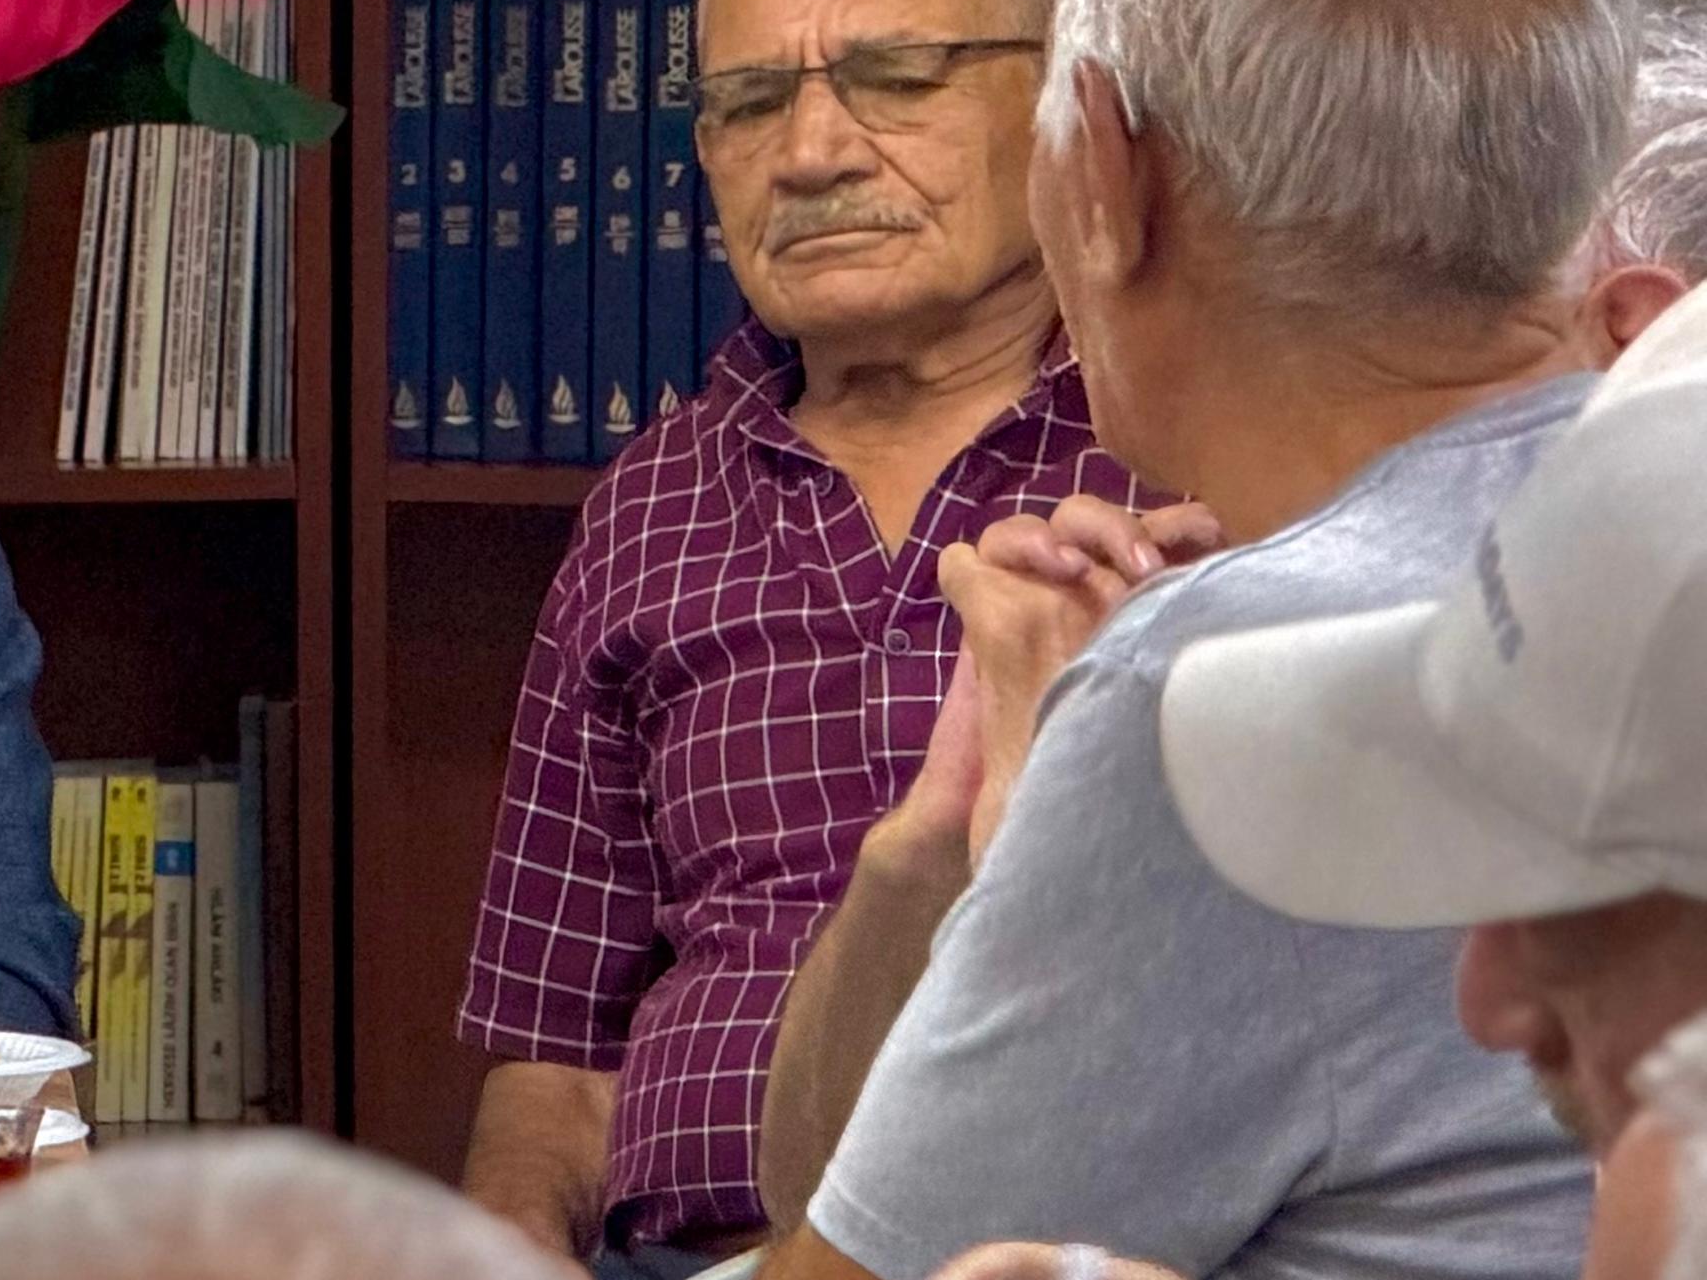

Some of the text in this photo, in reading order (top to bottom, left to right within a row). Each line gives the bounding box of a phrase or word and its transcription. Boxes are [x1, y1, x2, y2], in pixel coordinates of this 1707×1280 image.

[404, 5, 428, 107] LAROUSSE
[452, 1, 476, 104] LAROUSSE
[562, 0, 585, 103] LAROUSSE
[614, 8, 638, 112] LAROUSSE
[401, 164, 418, 186] 2
[447, 159, 467, 183] 3
[499, 162, 519, 184] 4
[558, 157, 577, 182] 5
[612, 165, 632, 190] 6
[664, 163, 685, 188] 7
